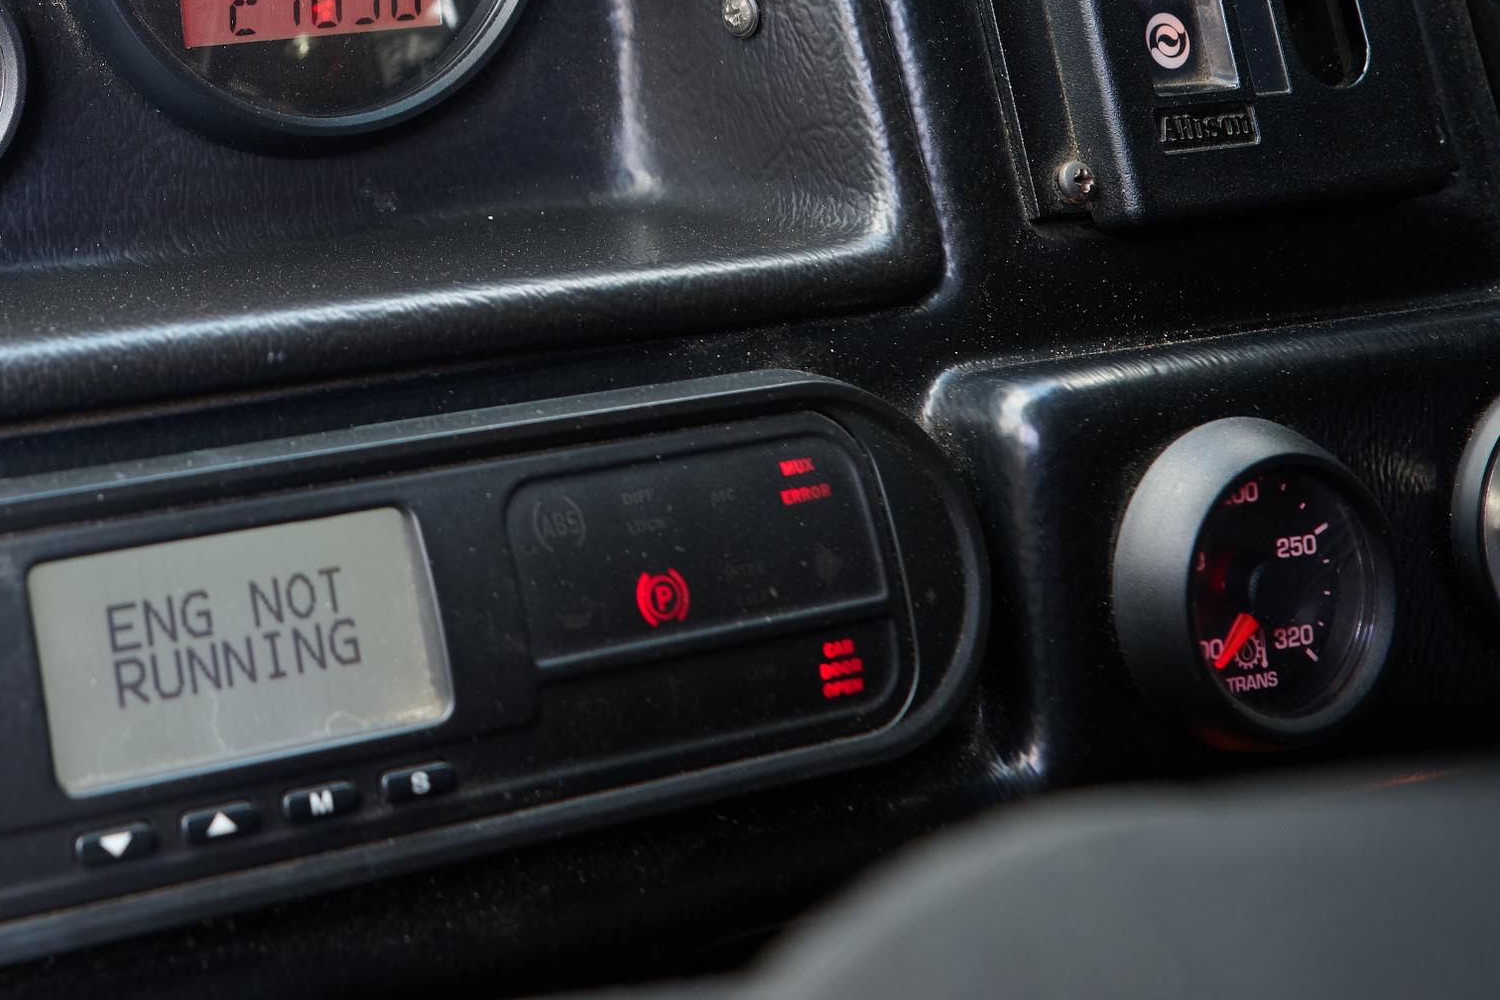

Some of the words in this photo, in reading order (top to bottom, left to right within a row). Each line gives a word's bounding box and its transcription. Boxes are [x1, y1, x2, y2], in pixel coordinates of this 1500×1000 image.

[780, 483, 832, 505] ERROR
[543, 510, 580, 539] ABS
[1276, 534, 1317, 559] 250
[105, 591, 213, 653] ENG
[248, 566, 342, 628] NOT
[1274, 624, 1314, 650] 320
[112, 618, 362, 709] RUNNING
[1226, 671, 1279, 694] TRANS
[410, 770, 431, 796] S
[309, 789, 334, 816] M
